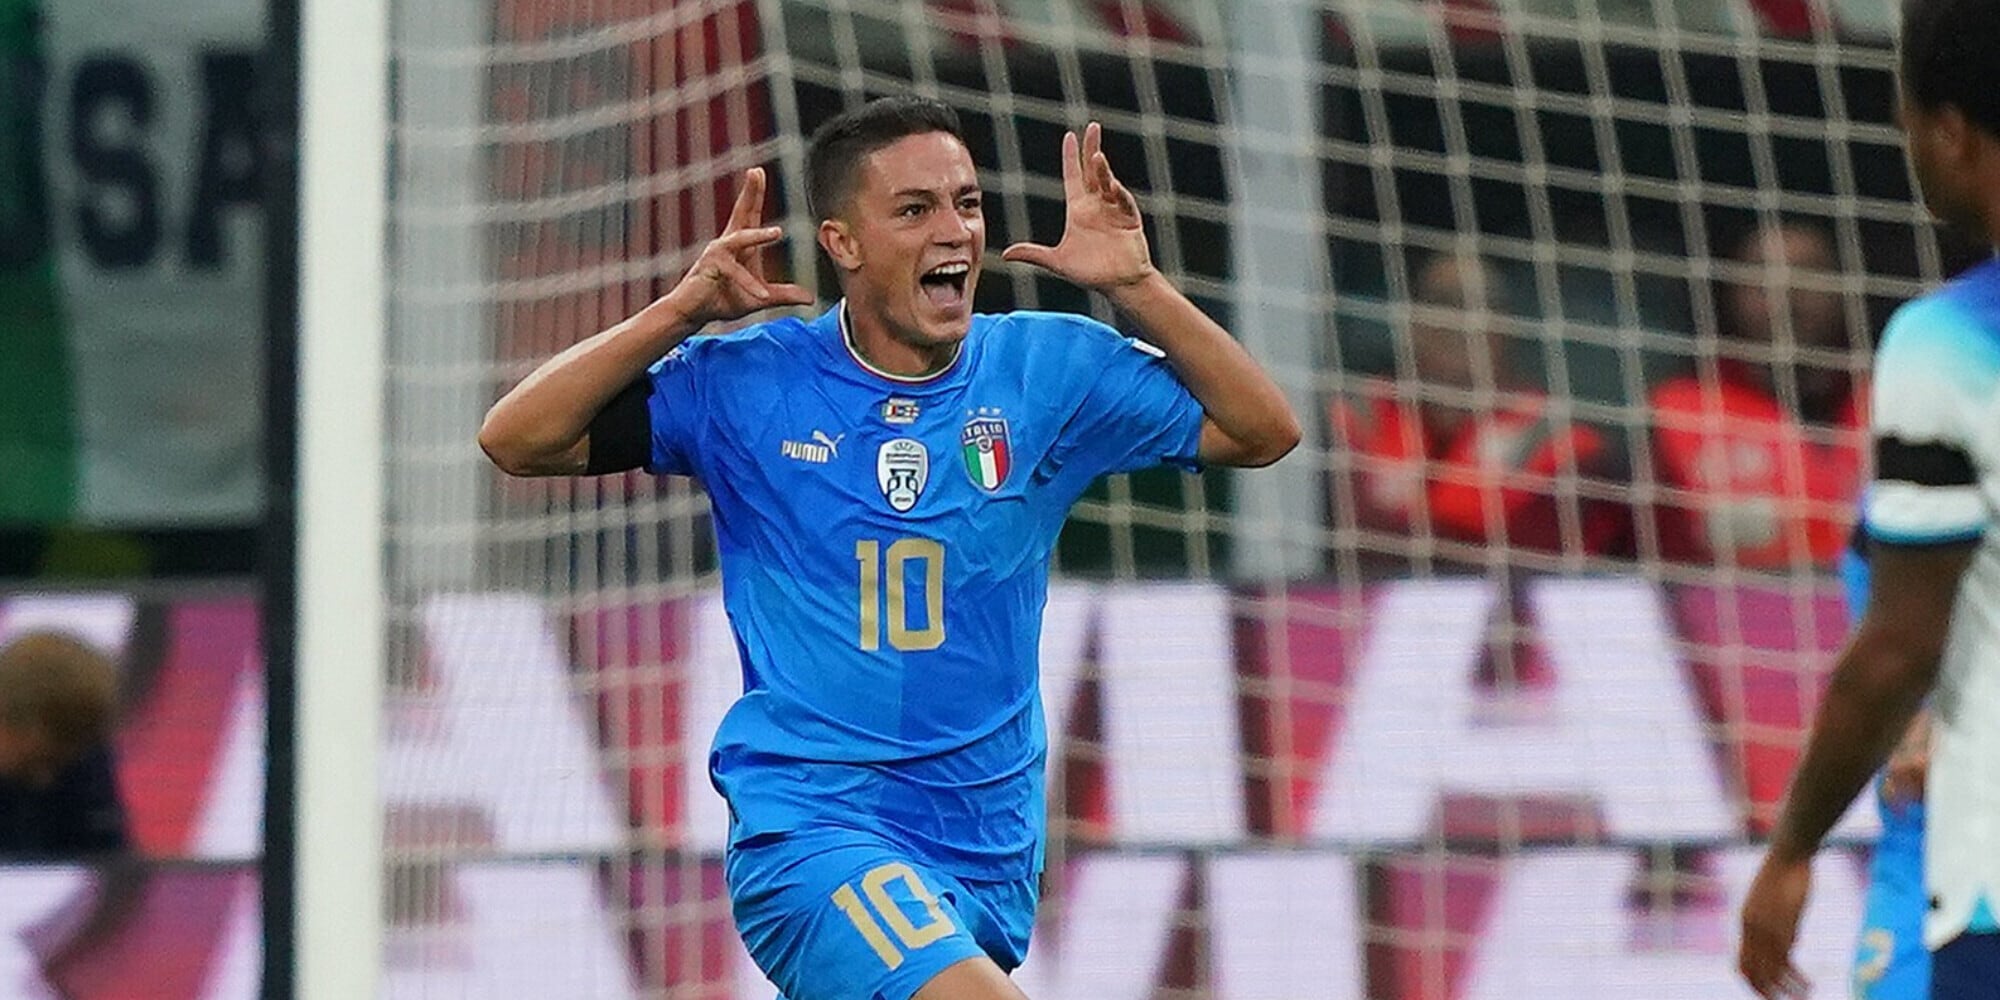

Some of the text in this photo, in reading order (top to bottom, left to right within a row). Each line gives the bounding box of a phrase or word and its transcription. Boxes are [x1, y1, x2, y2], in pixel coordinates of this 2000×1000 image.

[781, 439, 829, 462] PUMA
[961, 423, 1003, 439] ITALIA
[856, 539, 945, 651] 10
[830, 861, 956, 972] 10
